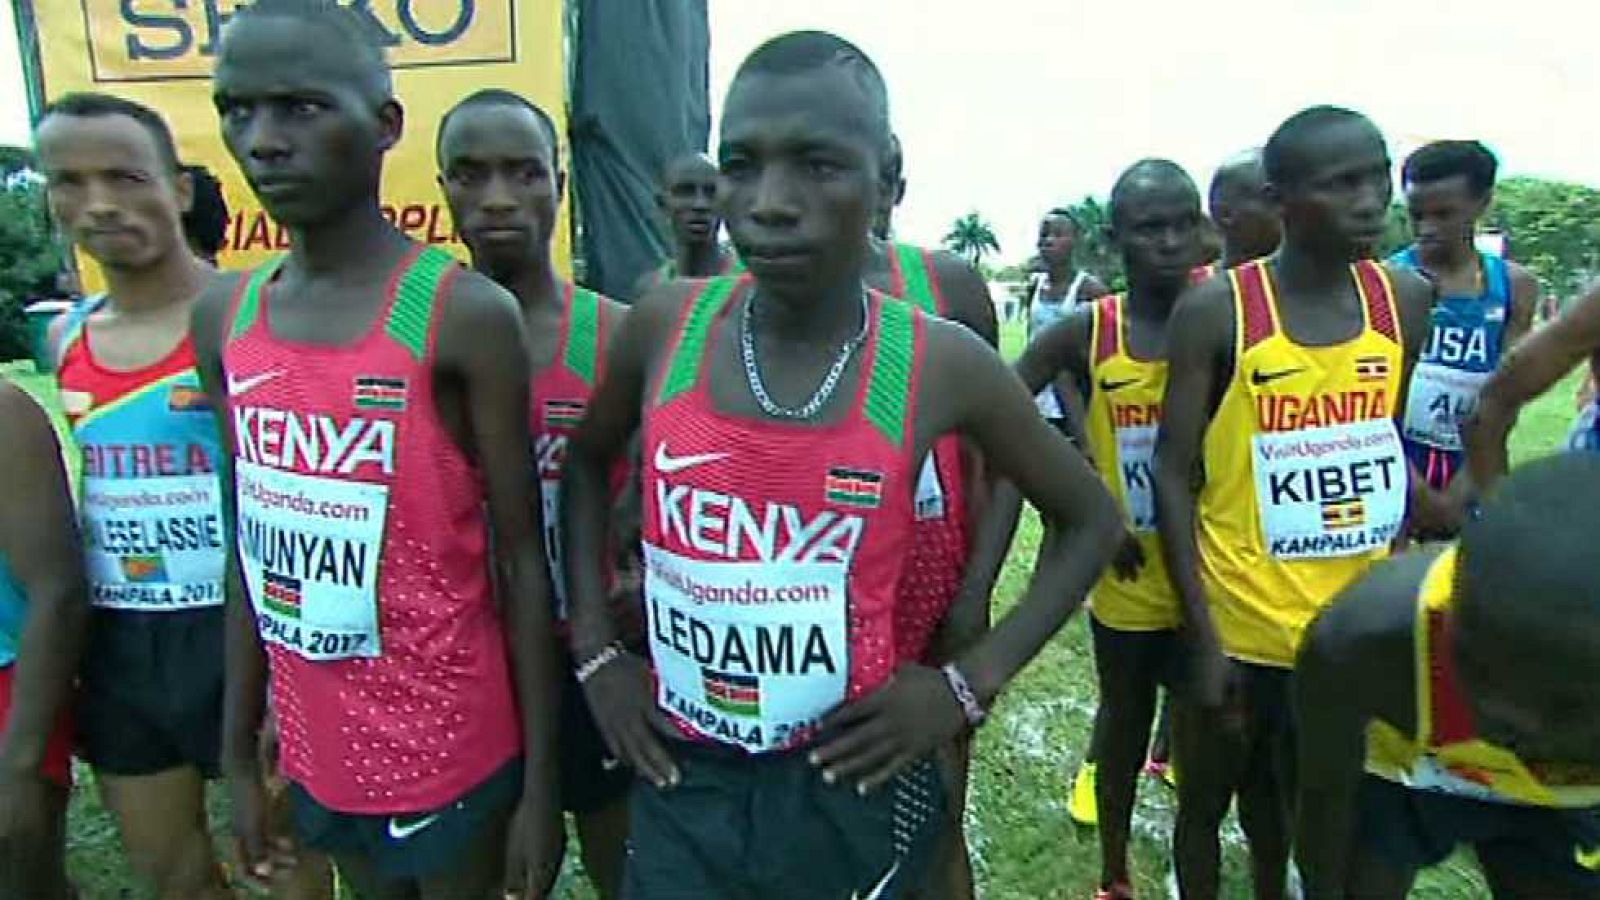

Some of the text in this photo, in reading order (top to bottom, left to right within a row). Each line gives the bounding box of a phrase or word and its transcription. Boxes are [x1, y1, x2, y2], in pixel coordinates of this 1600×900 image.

[1257, 390, 1388, 433] UGANDA
[234, 406, 395, 475] KENYA
[1269, 457, 1397, 506] KIBET
[656, 478, 864, 562] KENYA
[1272, 532, 1366, 556] KAMPALA
[258, 613, 368, 655] PALA 2017
[652, 597, 836, 675] LEDAMA
[664, 687, 763, 745] KAMPALA
